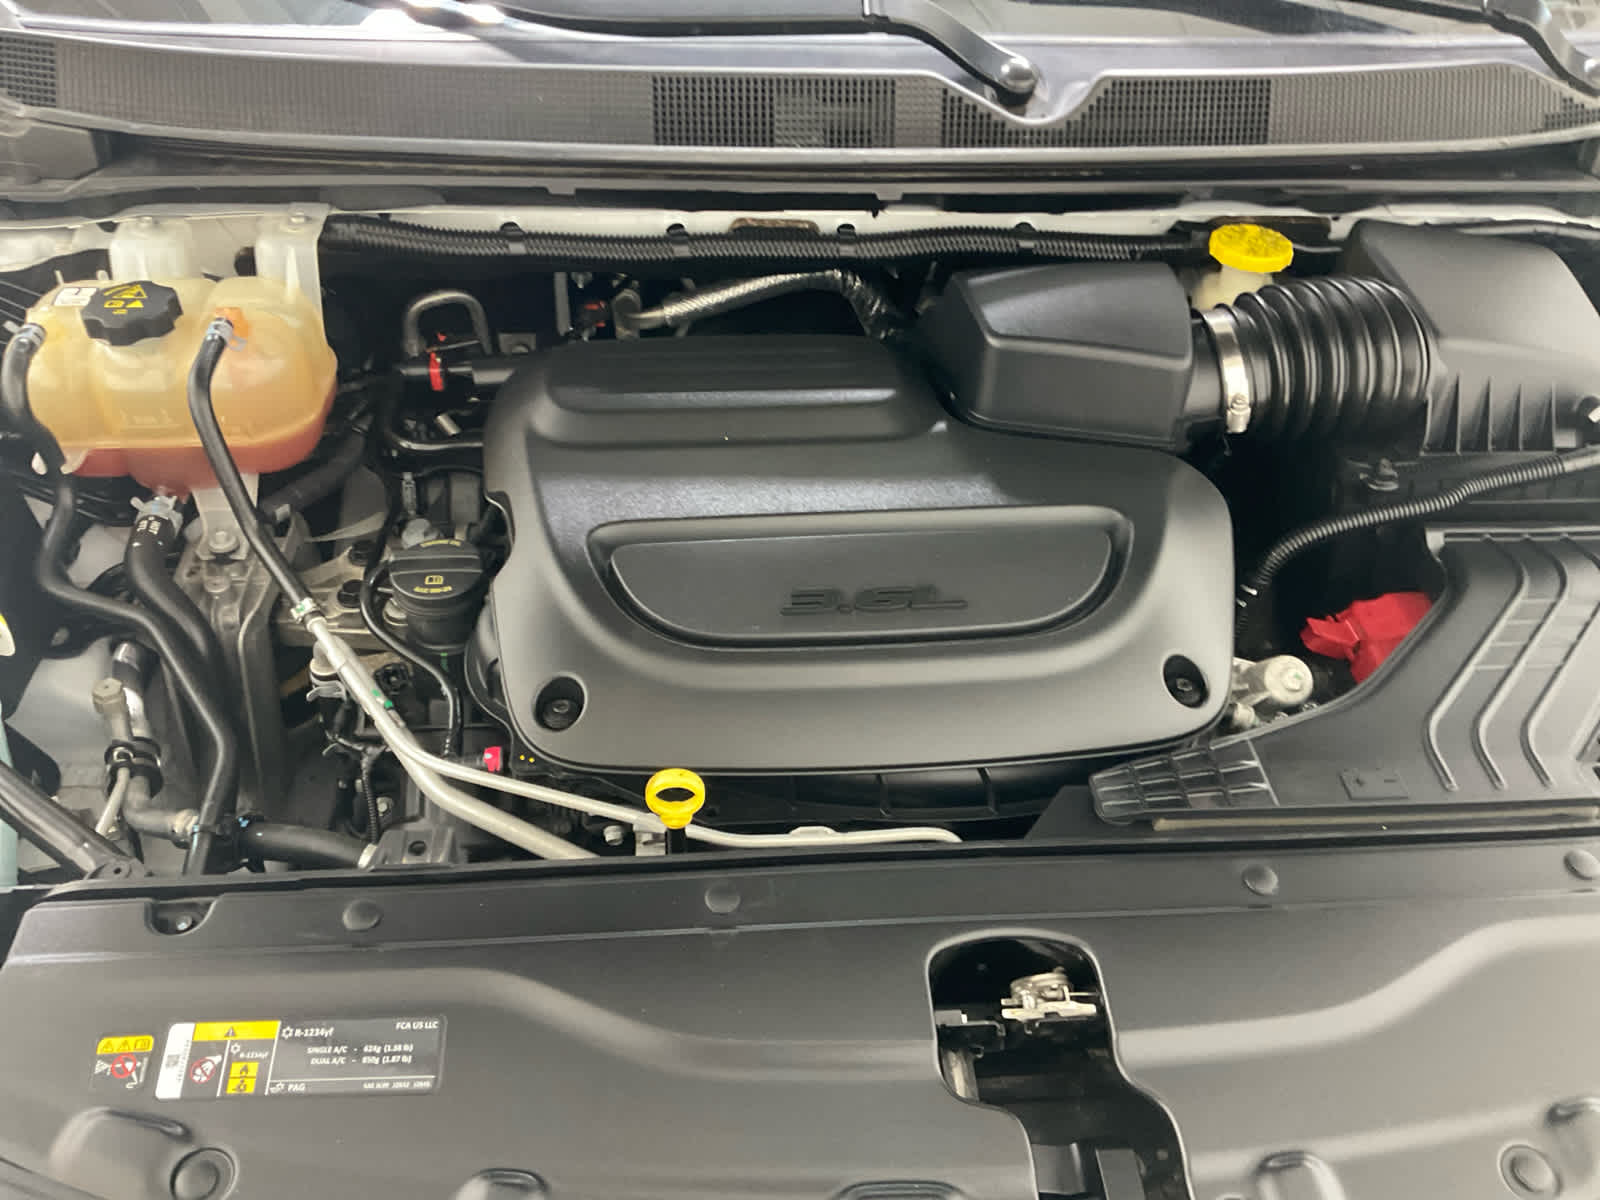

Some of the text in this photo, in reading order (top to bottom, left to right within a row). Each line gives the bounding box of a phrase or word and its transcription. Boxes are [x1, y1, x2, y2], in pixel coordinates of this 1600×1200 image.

[779, 584, 969, 617] 3.6L
[395, 1021, 411, 1030] FCA
[424, 1021, 439, 1029] LLC
[287, 1082, 306, 1092] PAG
